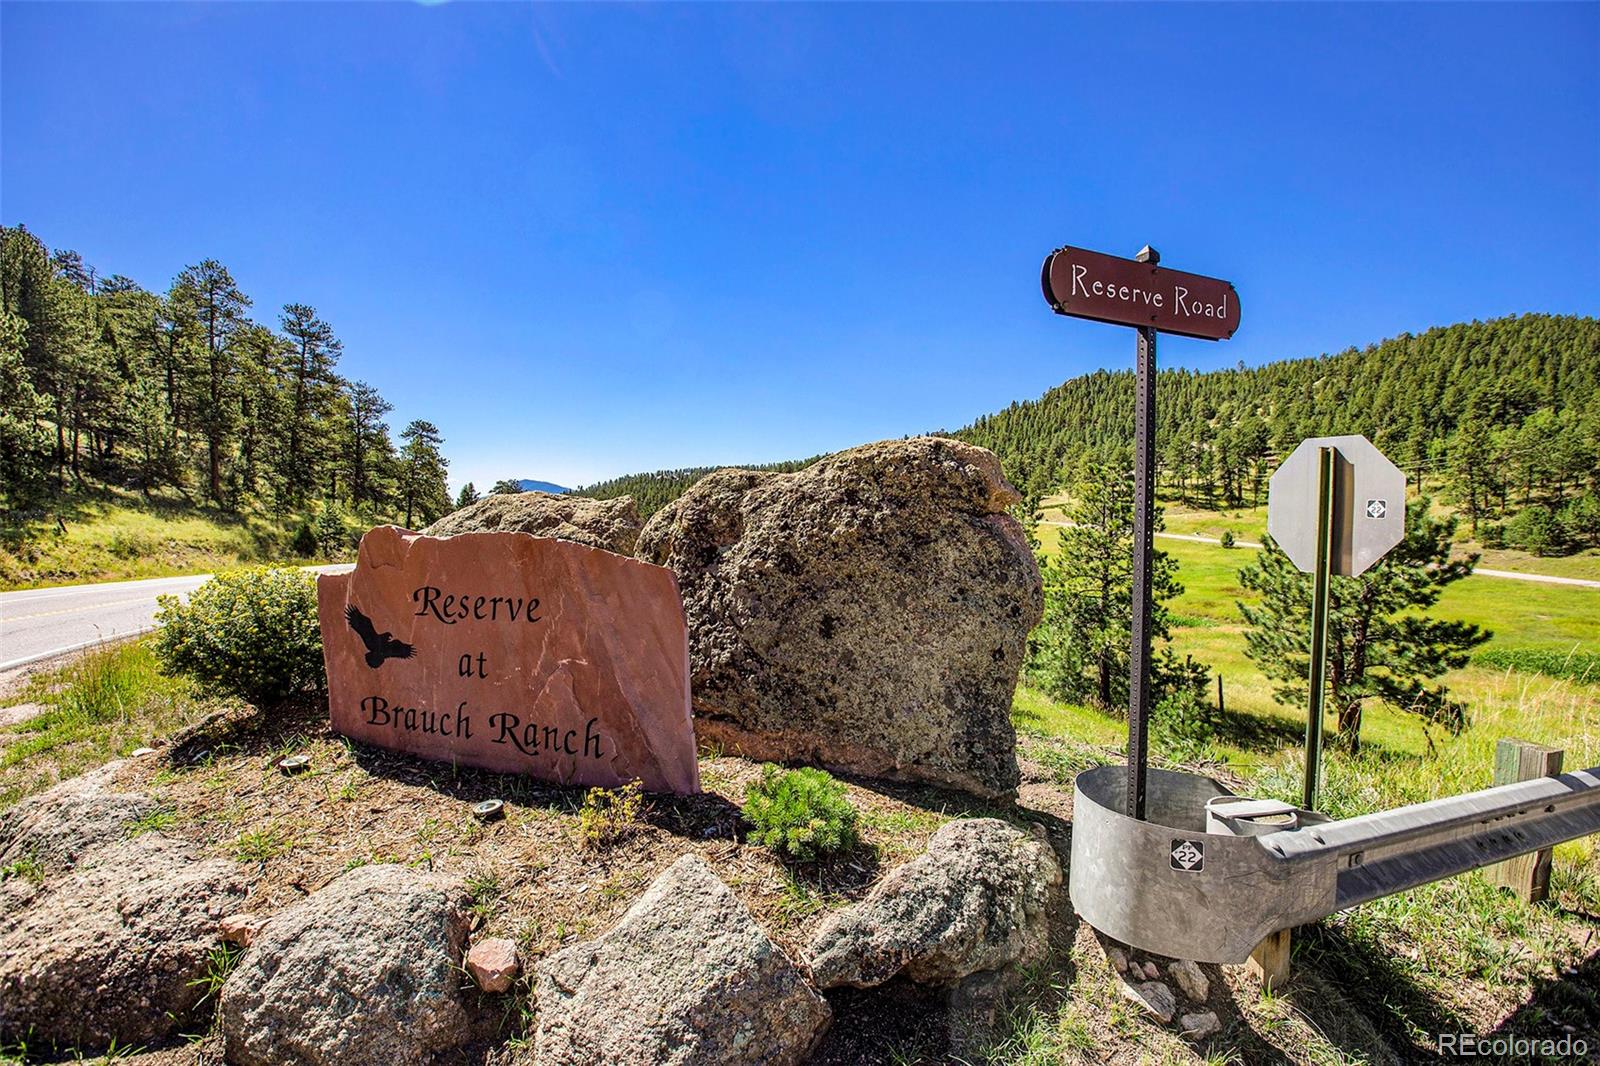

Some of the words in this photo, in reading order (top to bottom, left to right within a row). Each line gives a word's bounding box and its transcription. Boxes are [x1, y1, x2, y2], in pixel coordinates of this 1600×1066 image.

[1071, 264, 1164, 307] Reserve
[1174, 285, 1227, 319] Road
[1371, 506, 1382, 514] 22
[412, 586, 543, 625] Reserve
[458, 652, 488, 679] at
[360, 696, 473, 739] Brauch
[489, 712, 605, 759] Ranch
[1178, 850, 1196, 863] 22
